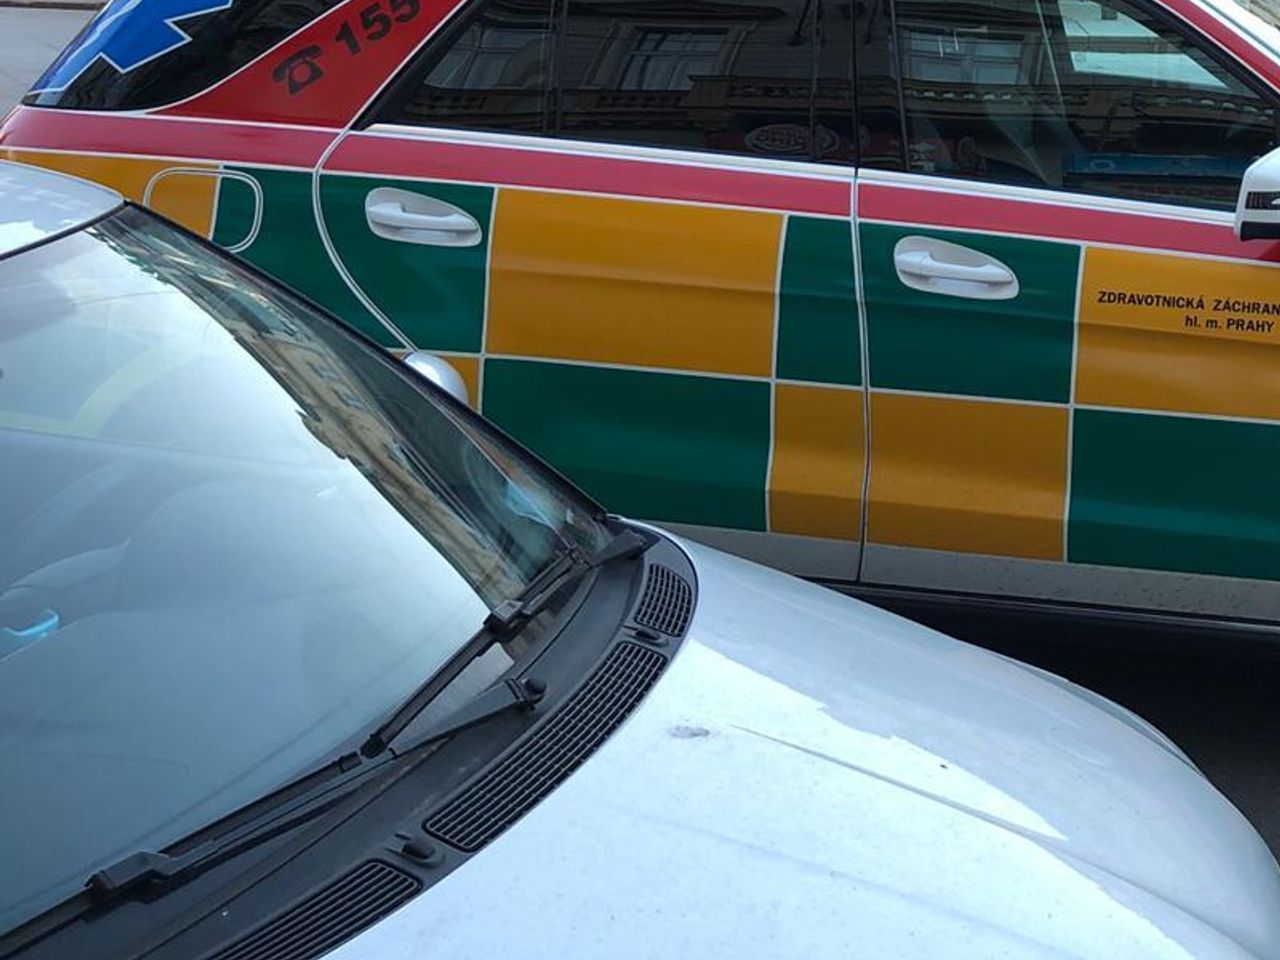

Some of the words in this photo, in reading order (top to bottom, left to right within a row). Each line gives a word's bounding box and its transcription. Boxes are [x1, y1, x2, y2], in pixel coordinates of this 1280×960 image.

[1098, 290, 1206, 310] ZDRAVOTNICKÁ
[1184, 314, 1202, 328] hl.
[1205, 319, 1223, 330] m.
[1226, 317, 1276, 333] PRAHY
